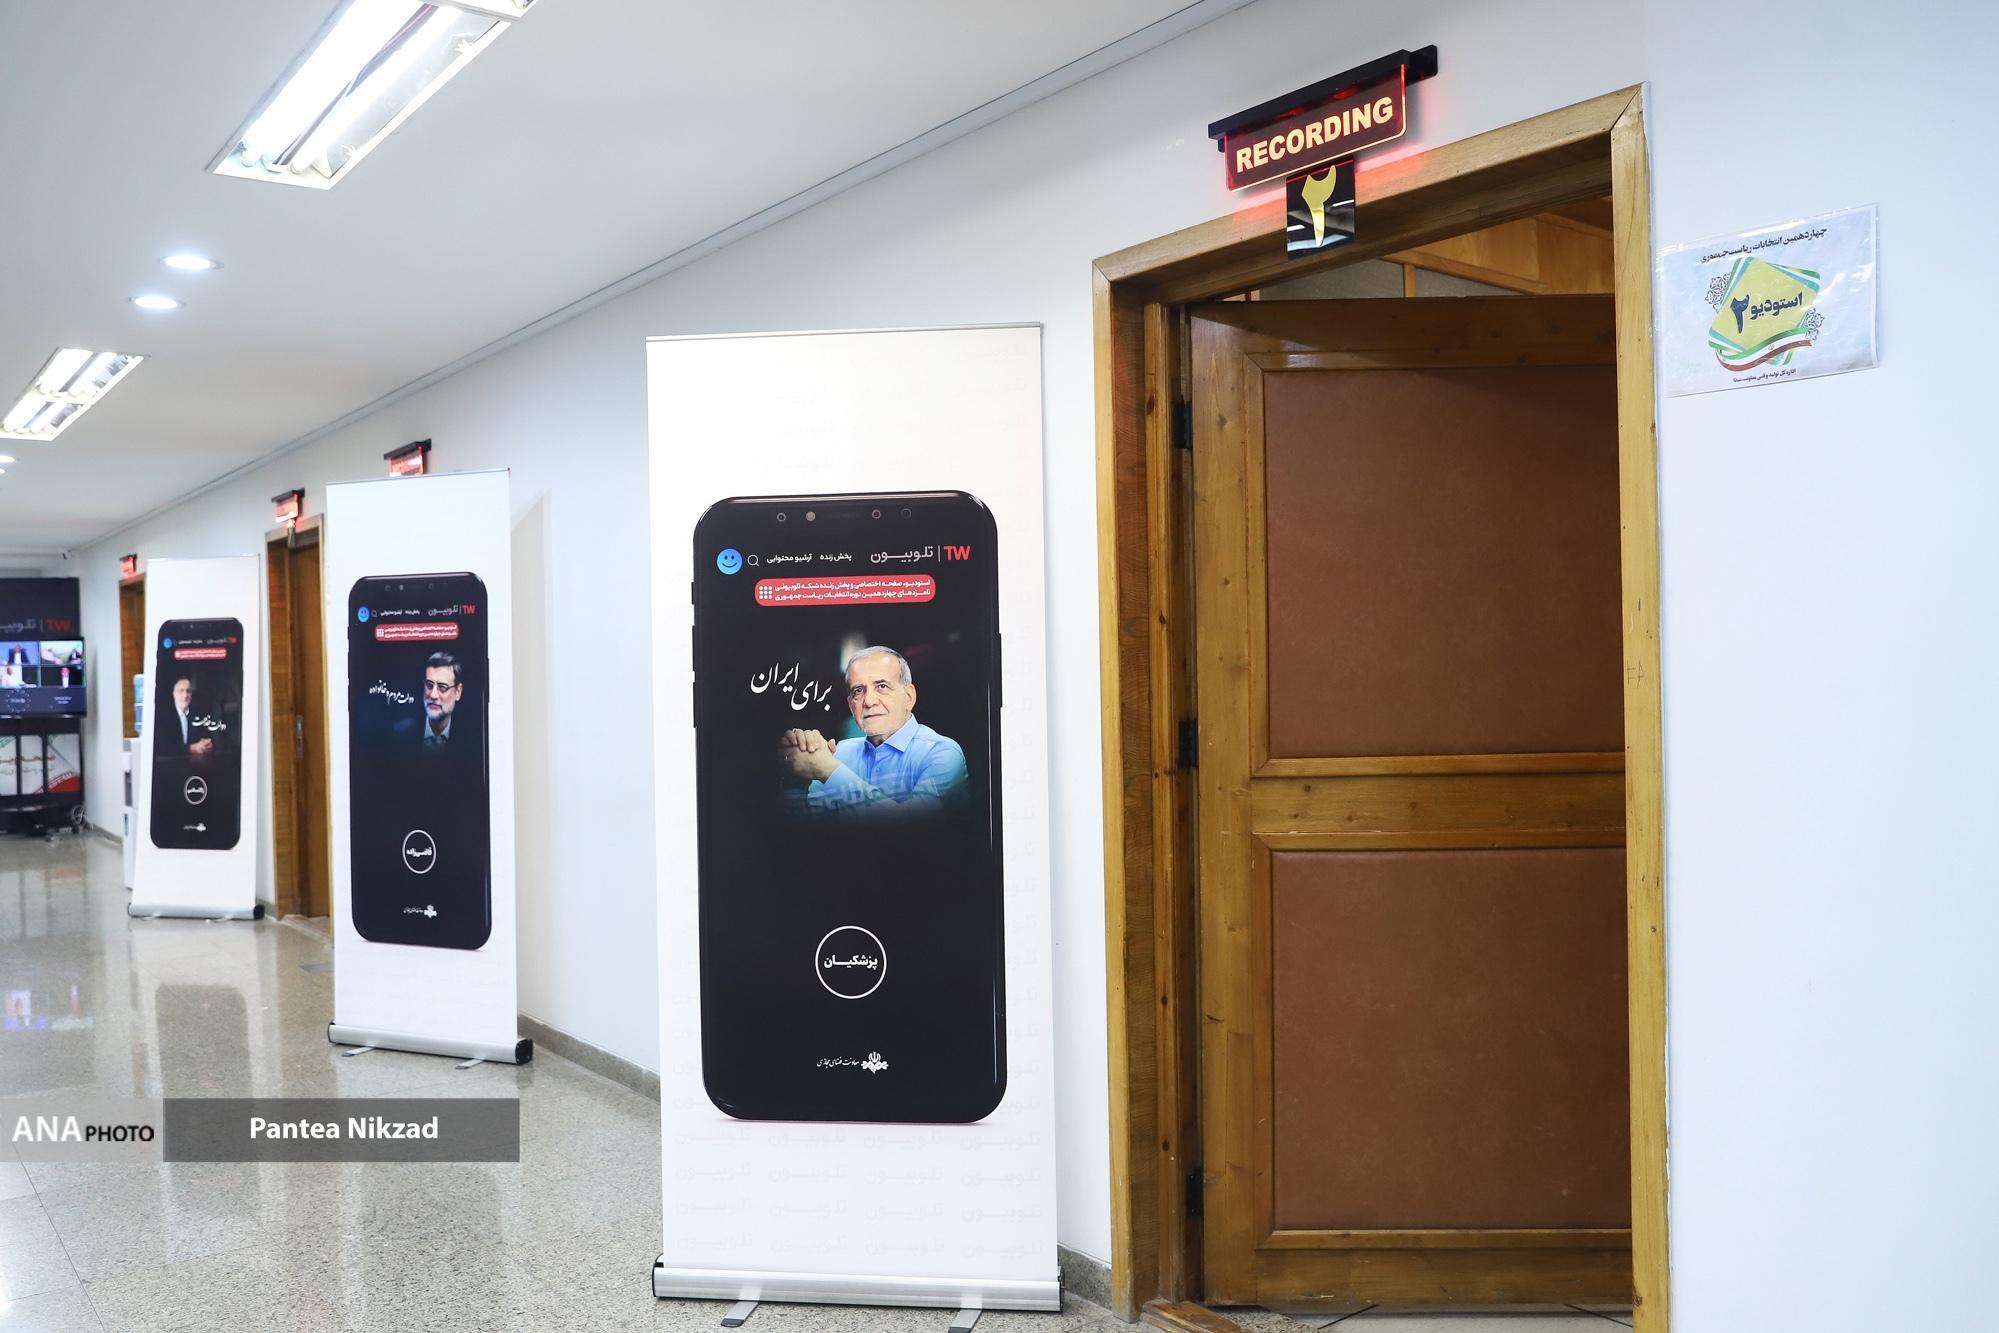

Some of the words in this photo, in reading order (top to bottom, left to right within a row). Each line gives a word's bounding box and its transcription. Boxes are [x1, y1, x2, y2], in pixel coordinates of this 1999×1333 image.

[1236, 96, 1393, 173] RECORDING
[1301, 165, 1337, 247] ۲
[1752, 236, 1783, 251] انتخابات
[1783, 228, 1827, 245] چهاردهمین
[1729, 294, 1750, 334] ۲
[1750, 292, 1803, 320] استودیو
[766, 554, 794, 564] محتوایی
[794, 553, 813, 563] آرشیو
[820, 553, 834, 562] زنده
[833, 552, 852, 562] پخش
[870, 545, 934, 563] تلوبیون
[943, 545, 971, 561] TW
[750, 662, 800, 694] ایران
[790, 680, 833, 712] برای
[823, 954, 878, 971] پزشکیان
